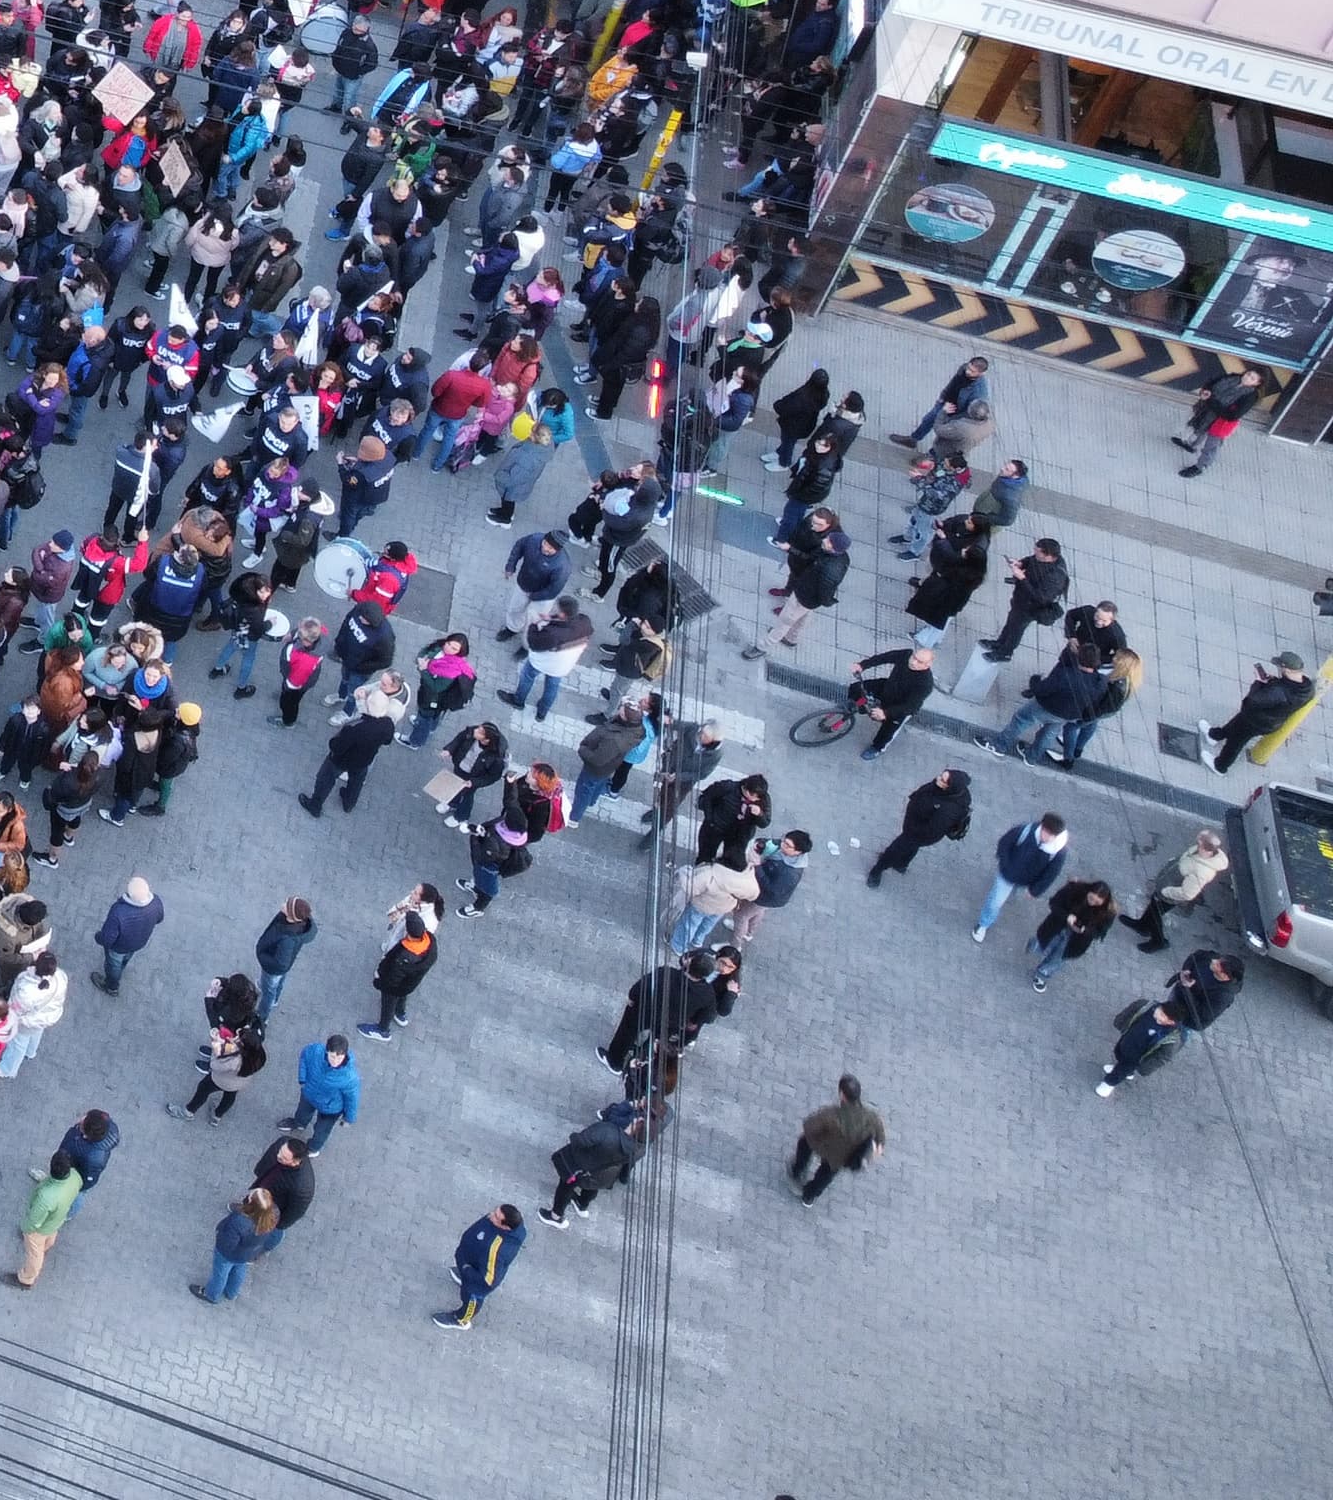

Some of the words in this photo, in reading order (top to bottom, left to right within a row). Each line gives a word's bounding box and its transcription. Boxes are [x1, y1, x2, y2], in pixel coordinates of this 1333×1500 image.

[981, 2, 1144, 59] TRIBUNAL
[1157, 45, 1250, 83] ORAL
[1267, 70, 1317, 97] EN
[1232, 312, 1293, 338] Vermú
[158, 346, 185, 364] UPCN
[347, 362, 372, 381] UPCN
[264, 427, 289, 451] UPCN
[348, 616, 368, 643] UPCN
